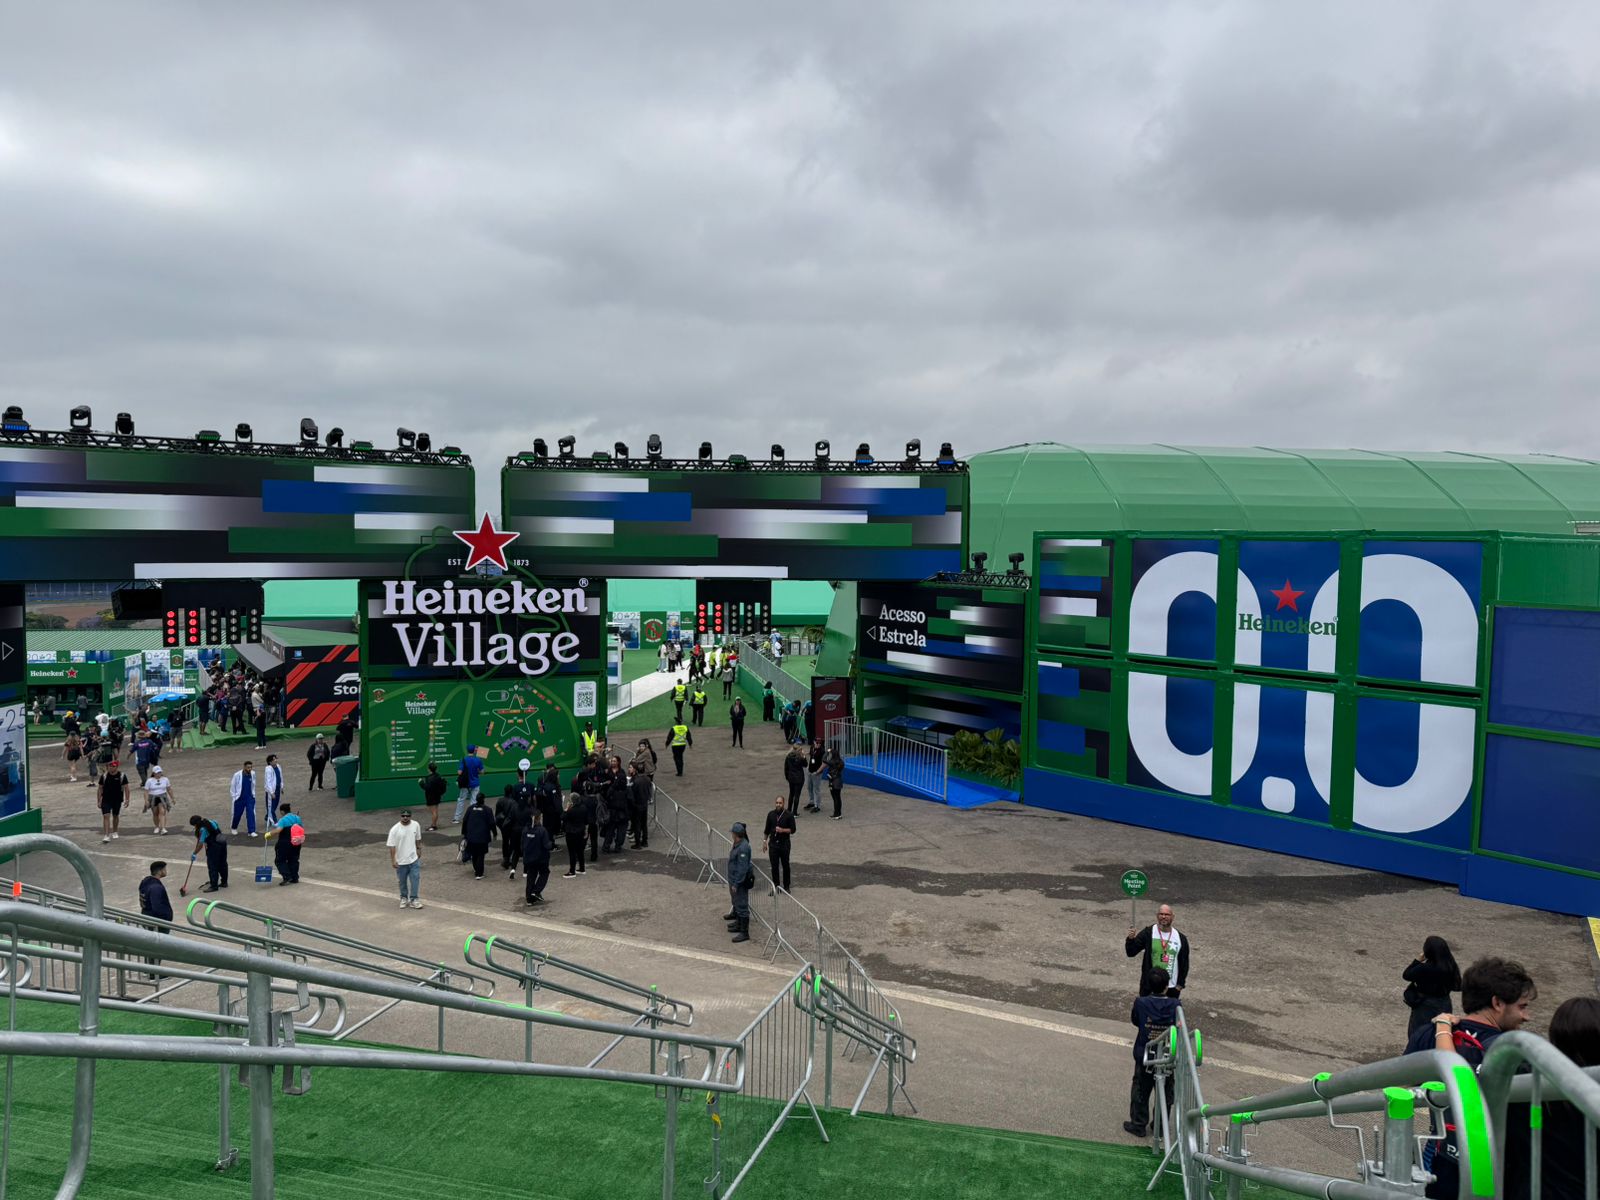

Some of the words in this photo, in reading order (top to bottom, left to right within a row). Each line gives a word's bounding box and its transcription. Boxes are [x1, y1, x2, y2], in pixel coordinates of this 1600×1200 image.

[447, 558, 461, 566] EST
[879, 603, 926, 624] Acesso
[879, 626, 927, 647] Estrela
[392, 621, 580, 676] Village
[406, 707, 436, 716] Village
